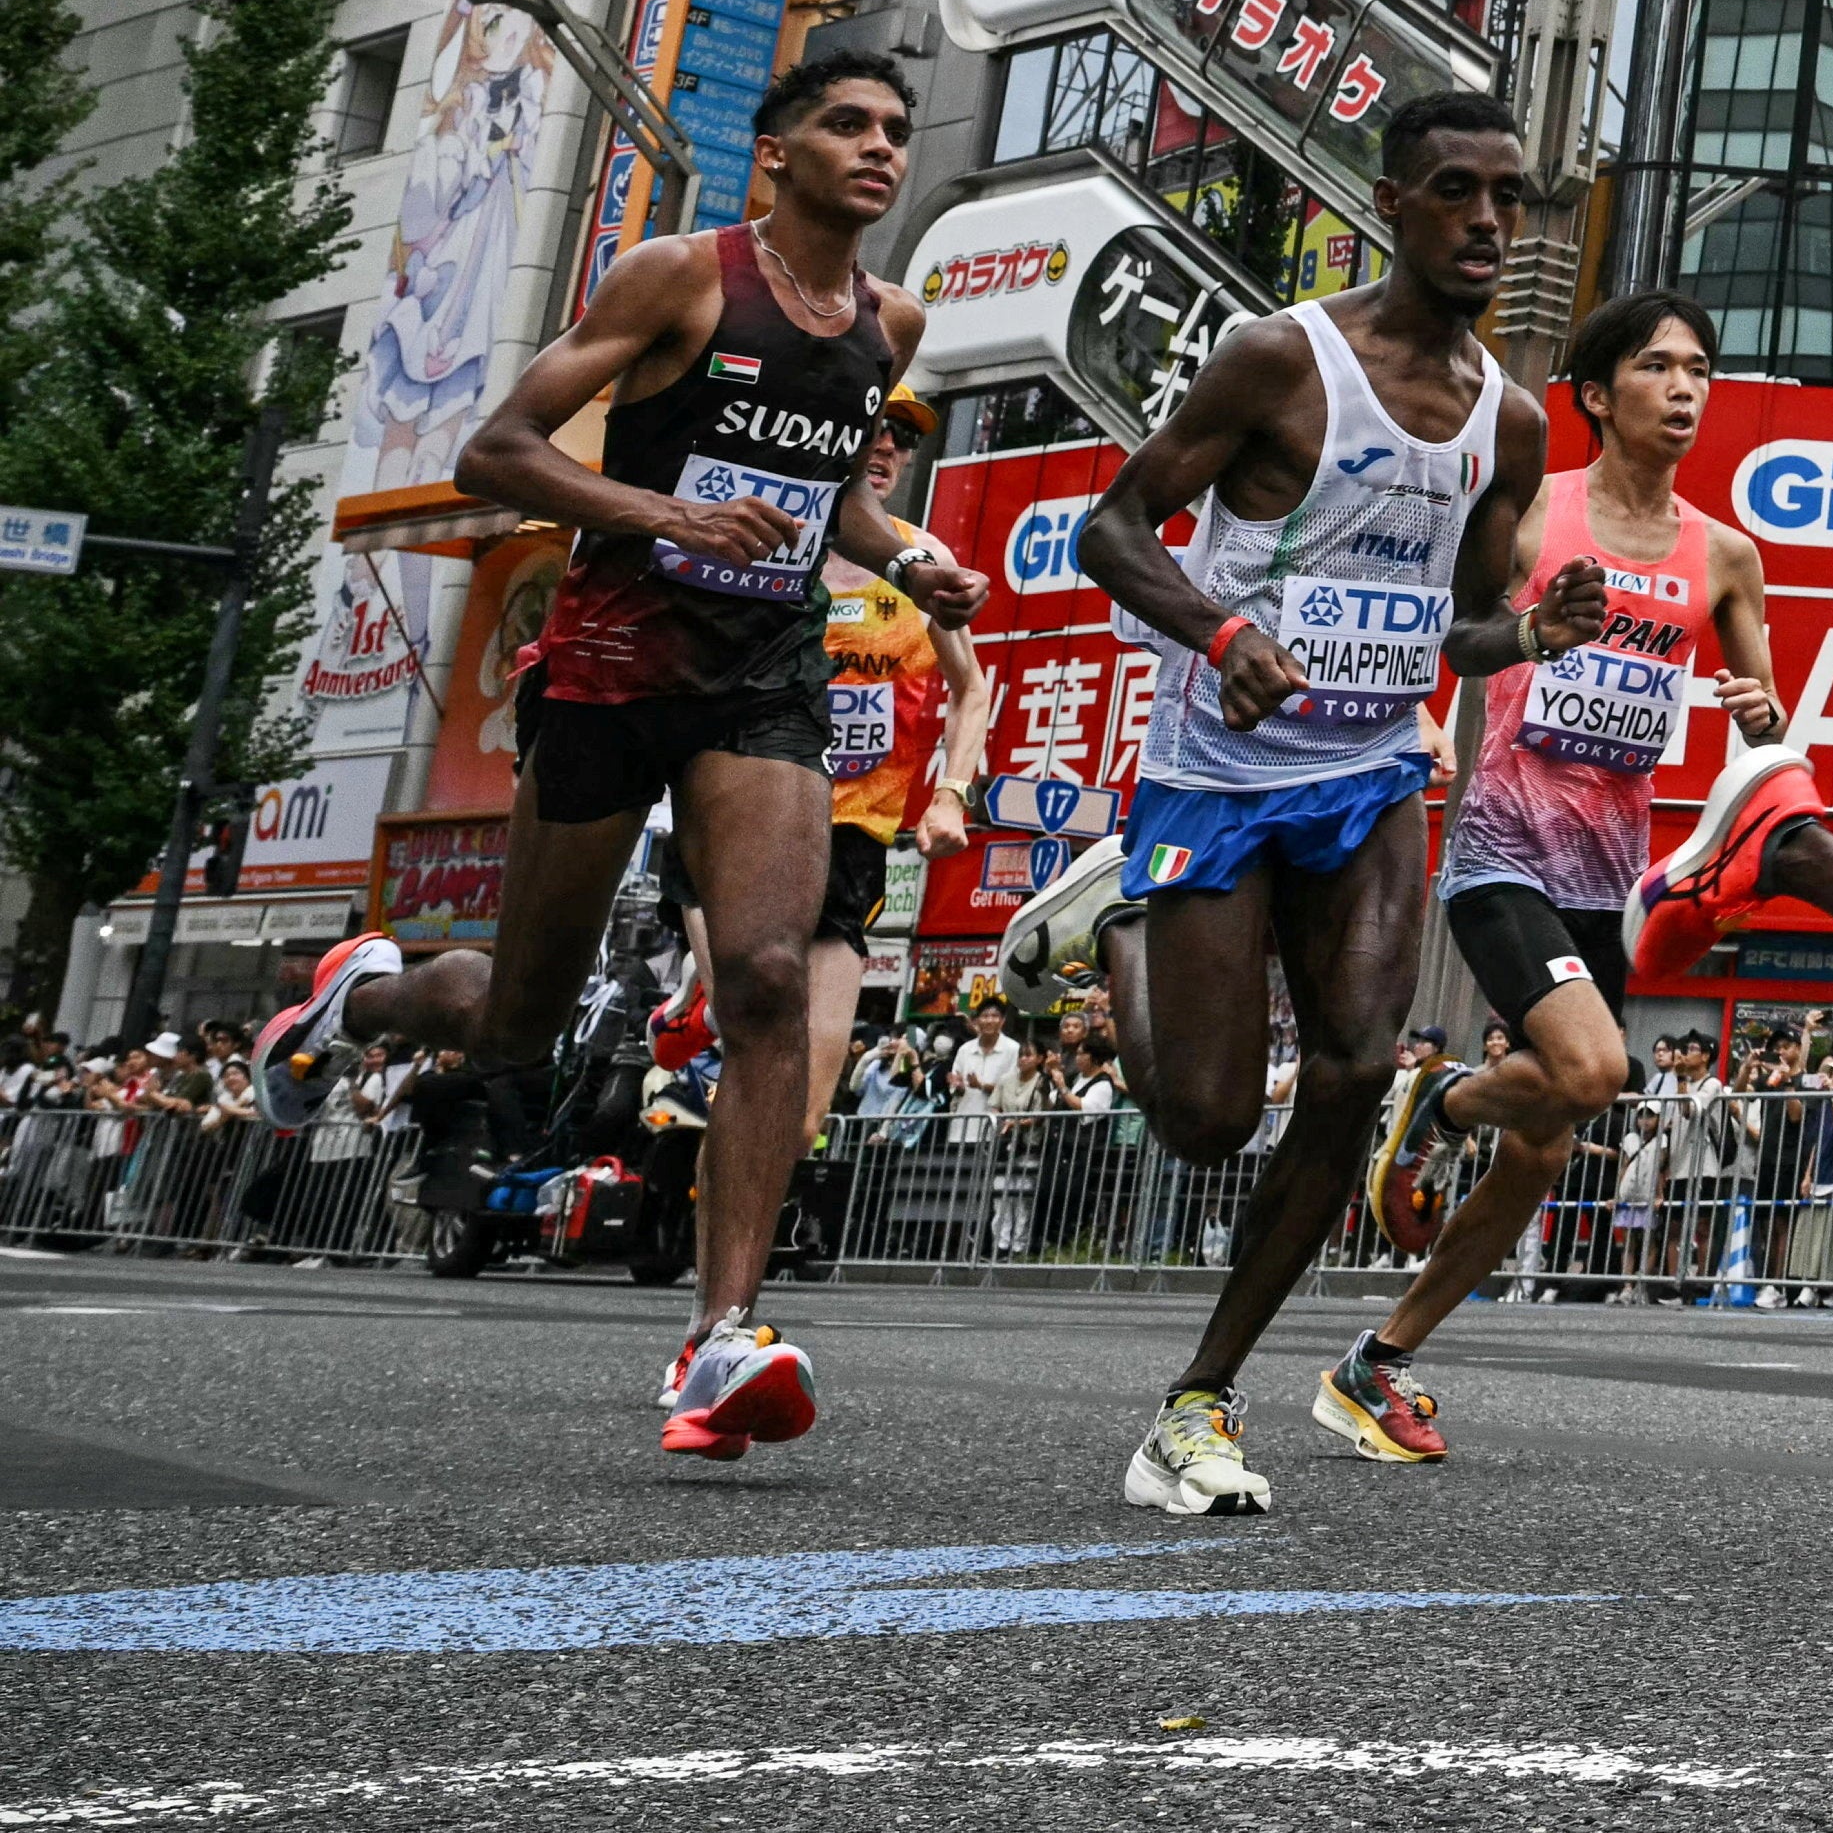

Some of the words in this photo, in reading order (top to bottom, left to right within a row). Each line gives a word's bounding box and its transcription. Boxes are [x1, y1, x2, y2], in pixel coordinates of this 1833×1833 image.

[941, 241, 1053, 304] カラオケ
[714, 400, 863, 459] SUDAN
[740, 471, 832, 521] TDK
[1350, 532, 1431, 564] ITALIA
[348, 599, 390, 657] 1st
[1346, 587, 1449, 635] TDK
[303, 643, 420, 700] Anniversary
[1287, 636, 1440, 687] CHIAPPINELLI
[1588, 651, 1678, 702] TDK
[1540, 686, 1669, 745] YOSHIDA
[1046, 785, 1073, 819] 17
